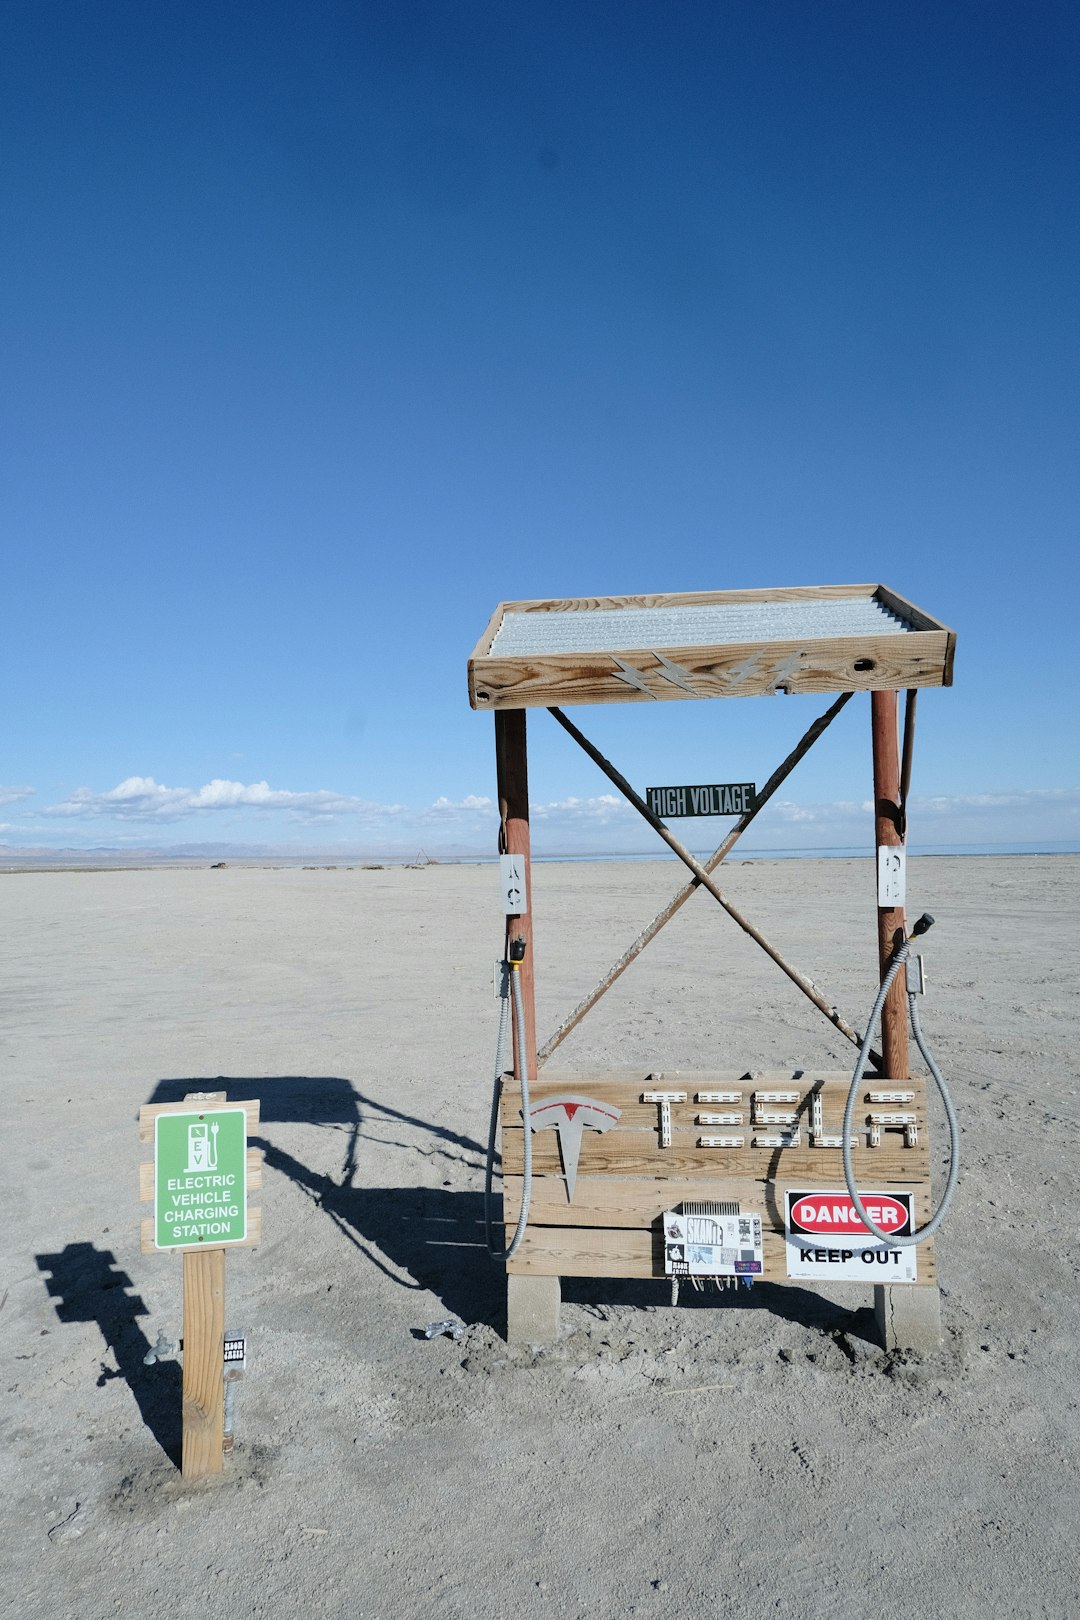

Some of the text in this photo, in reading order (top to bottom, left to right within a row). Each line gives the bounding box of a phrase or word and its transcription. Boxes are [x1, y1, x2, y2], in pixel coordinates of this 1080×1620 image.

[651, 785, 752, 816] HIGH VOLTAGE
[643, 1091, 918, 1149] TESLA
[167, 1174, 236, 1191] ELECTRIC
[171, 1190, 231, 1207] VEHICLE
[164, 1205, 239, 1223] CHARGING
[172, 1221, 231, 1238] STATION
[800, 1248, 903, 1265] KEEP OUT
